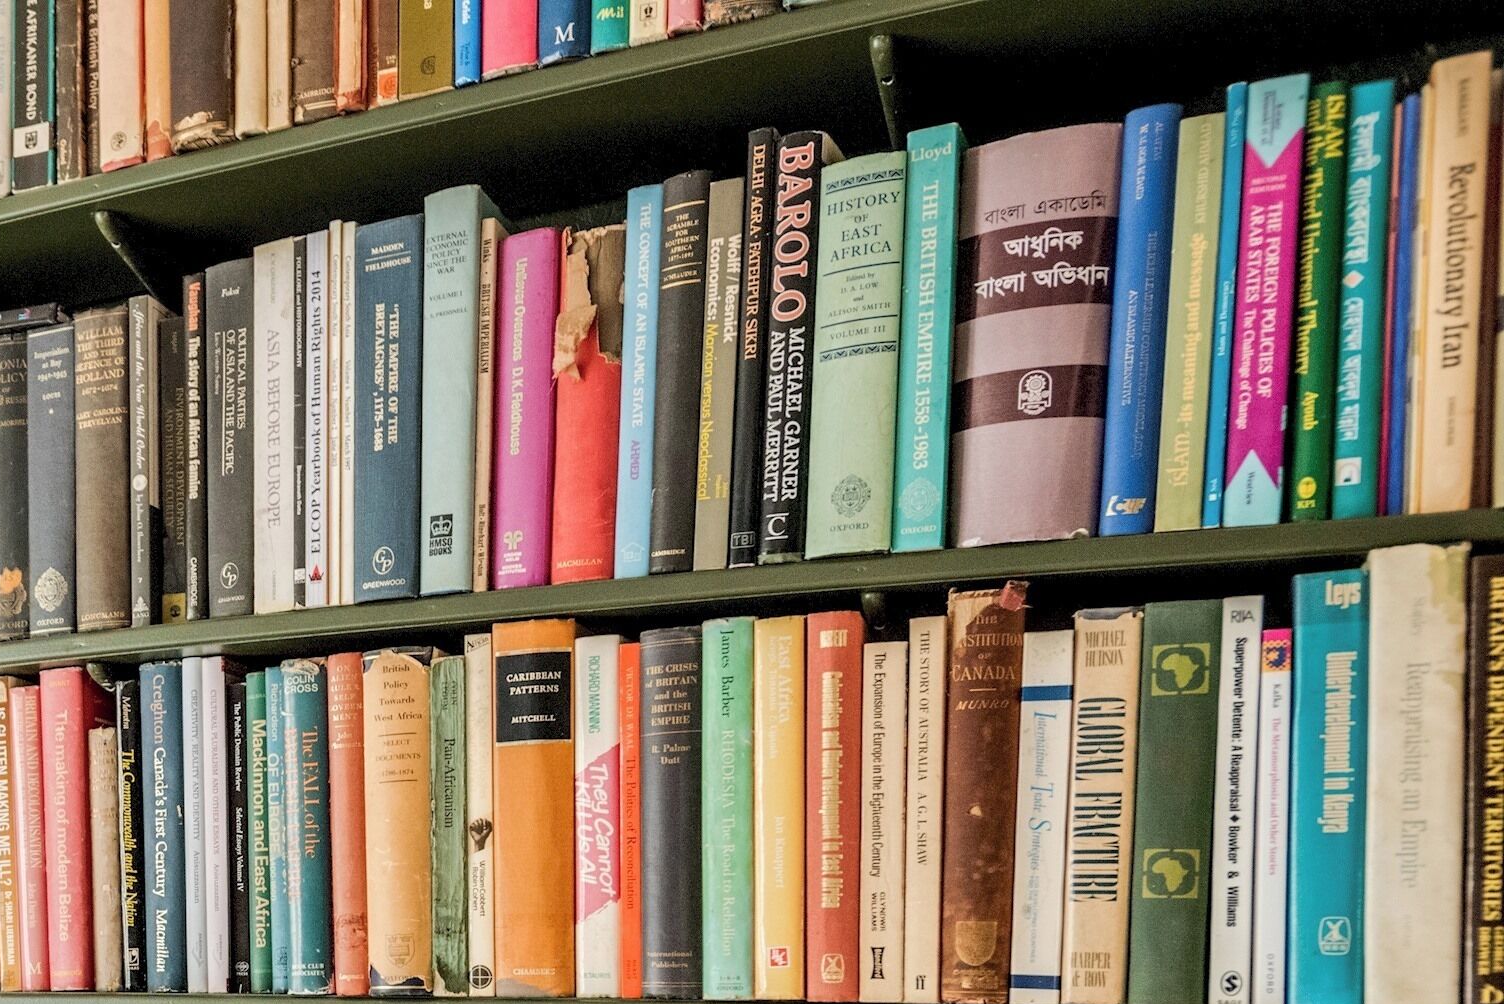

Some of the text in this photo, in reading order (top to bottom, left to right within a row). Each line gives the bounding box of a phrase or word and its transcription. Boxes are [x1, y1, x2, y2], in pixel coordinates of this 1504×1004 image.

[26, 11, 37, 120] AFRIKANER BOND
[827, 190, 901, 216] HISTORY
[854, 213, 869, 223] OF
[922, 184, 938, 224] THE
[984, 189, 1108, 224] বাংলা একাডেমি
[371, 242, 404, 256] MADDEN
[771, 140, 814, 323] BAROLO
[830, 240, 892, 262] AFRICA
[841, 224, 882, 242] EAST
[1003, 228, 1084, 258] আধুনিক
[365, 256, 412, 273] FIELDHOUSE
[744, 144, 765, 360] DELHI AGRA FATEHPUR SIKRI
[919, 226, 936, 305] BRITISH
[975, 261, 1110, 300] বাংলা অভিধান
[77, 326, 123, 341] WILLIAM
[77, 336, 125, 352] THE THIRD
[630, 204, 651, 480] THE CONCEPT OF AN ISLAMIC STATE AHMED
[916, 311, 933, 383] EMPIRE
[76, 368, 125, 385] HOLLAND
[188, 282, 200, 499] Vaughan The story of an African famine
[267, 329, 281, 529] ASIA BEFORE EUROPE
[310, 271, 323, 554] ELCOP Yearbook of Human Rights 2014
[763, 331, 785, 503] AND PAUL MERRITT
[782, 327, 806, 501] MICHAEL GARNER
[429, 538, 453, 549] HMSO
[429, 547, 453, 557] BOOKS
[733, 534, 754, 546] TBI
[506, 672, 562, 682] CARIBBEAN
[720, 629, 734, 718] James Barber
[1234, 638, 1248, 698] Superpower
[510, 684, 559, 695] PATTERNS
[511, 714, 556, 724] MITCHELL
[1232, 701, 1245, 743] Detente:
[1072, 697, 1127, 902] GLOBAL FRACTURE
[1230, 753, 1242, 812] Reappraisal
[151, 675, 168, 972] Creighton Canada's First Century Macmillan
[252, 720, 269, 948] Mackinnon and East Africa
[1227, 825, 1240, 864] Bowker
[0, 860, 10, 886] ILL?
[1226, 886, 1239, 927] Williams
